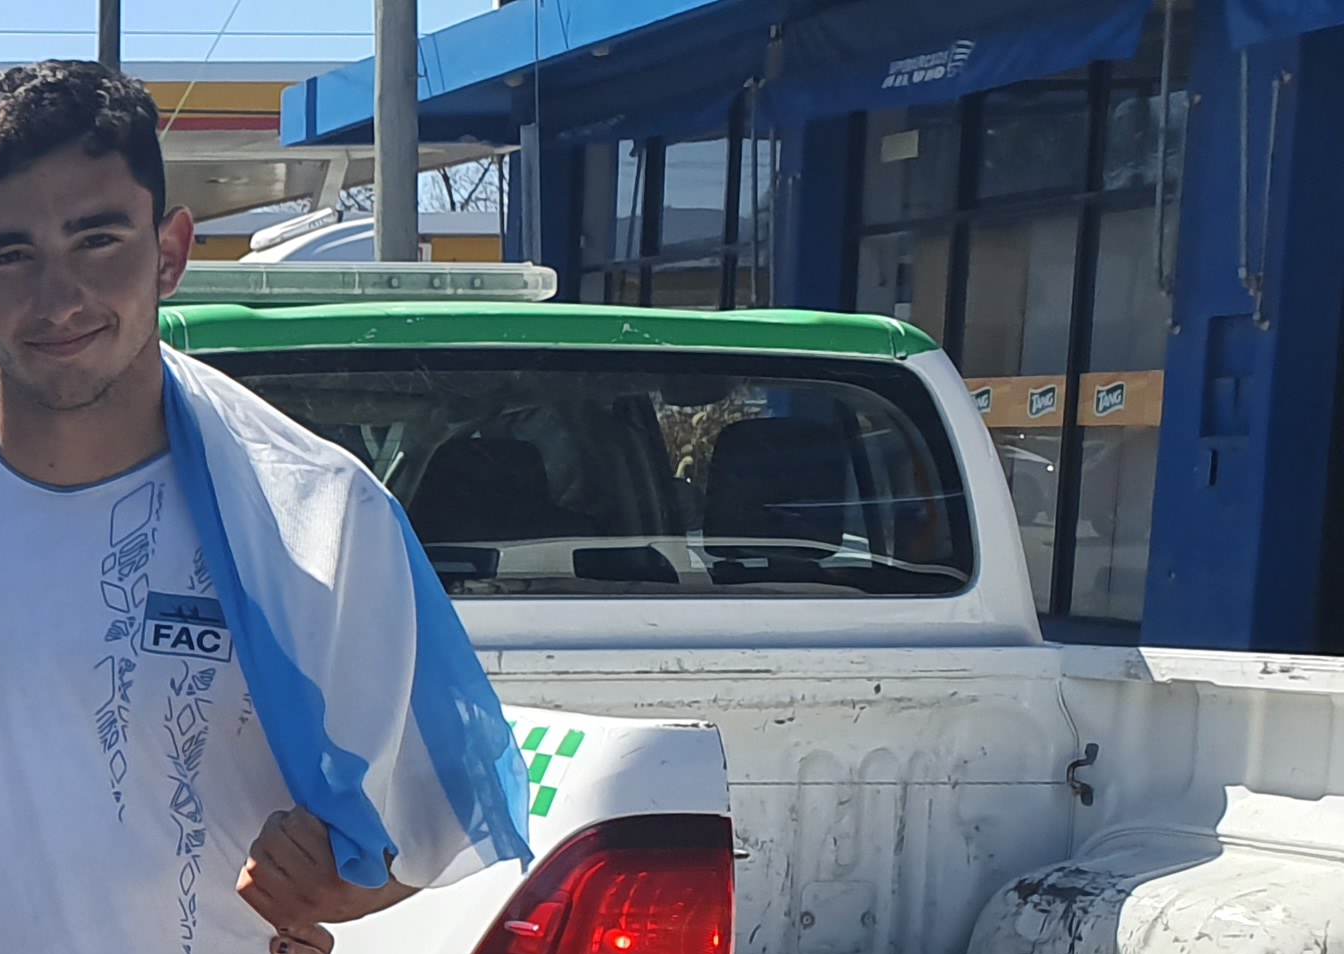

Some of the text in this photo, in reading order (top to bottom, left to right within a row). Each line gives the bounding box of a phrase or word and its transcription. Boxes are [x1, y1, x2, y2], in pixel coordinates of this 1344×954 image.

[1032, 392, 1054, 413] TANG
[1098, 387, 1122, 410] TANG
[152, 624, 221, 653] FAC
